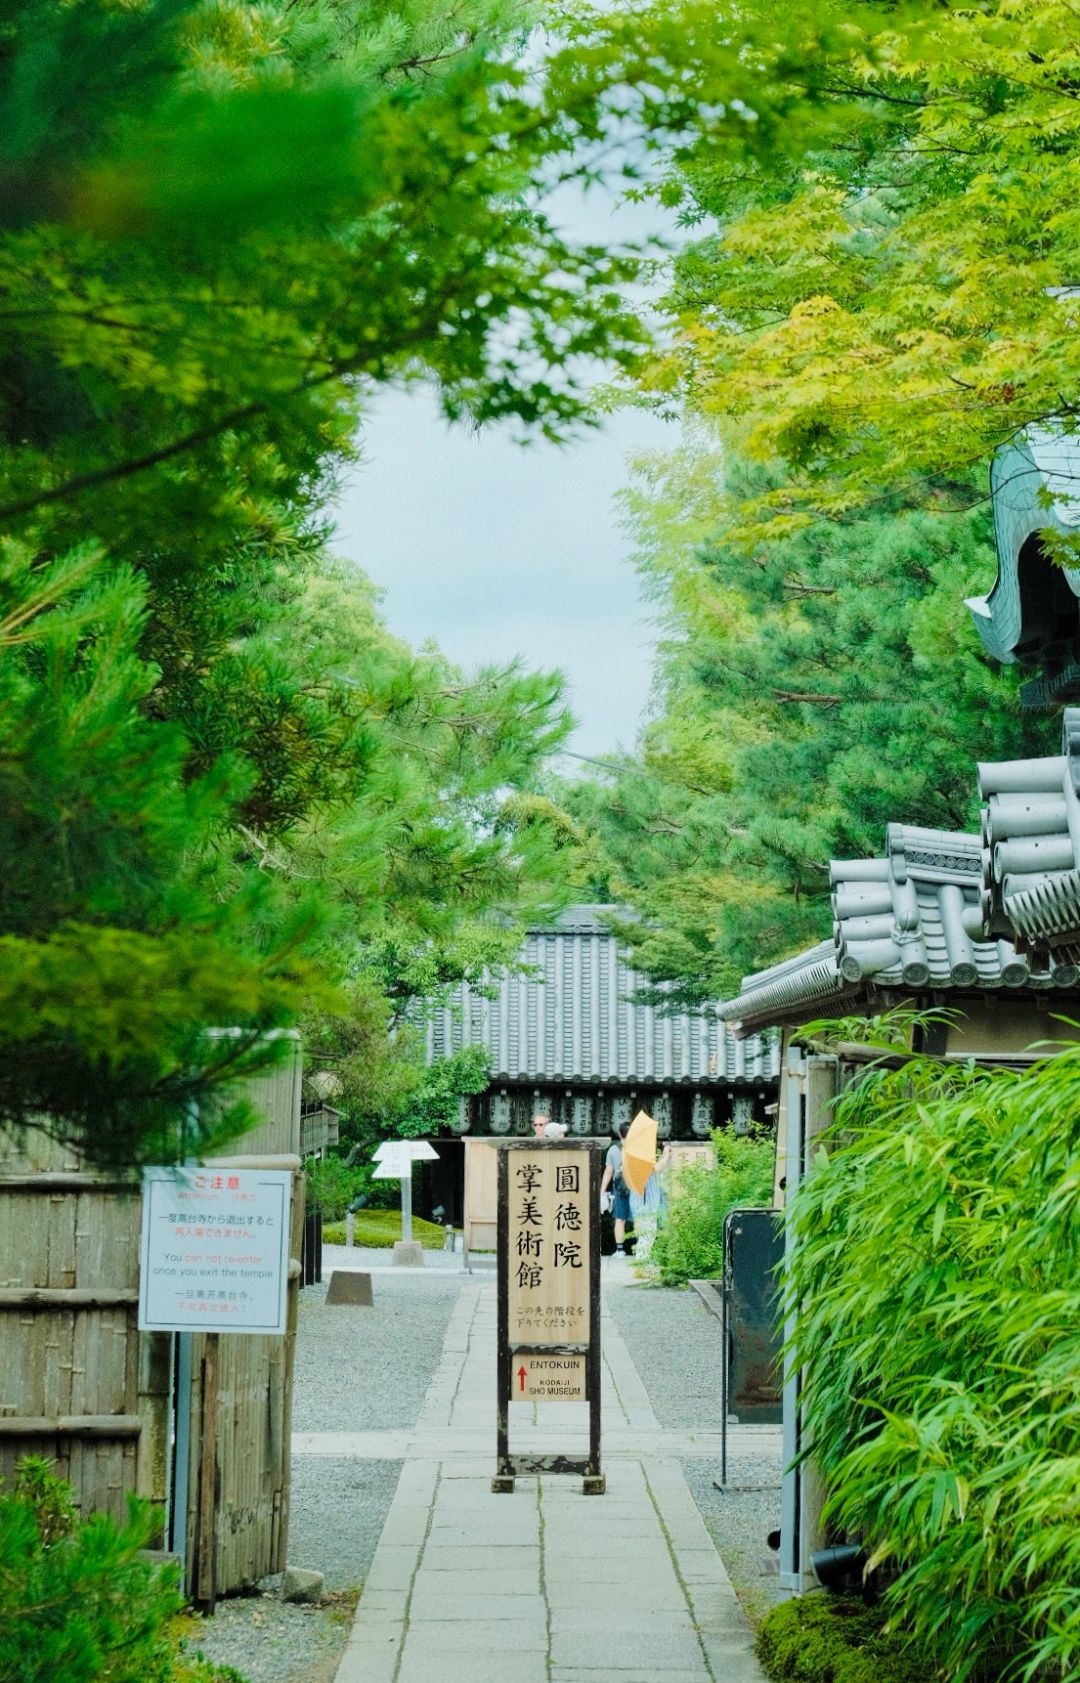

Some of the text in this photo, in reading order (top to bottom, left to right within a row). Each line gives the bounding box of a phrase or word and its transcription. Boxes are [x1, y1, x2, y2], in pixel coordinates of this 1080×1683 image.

[195, 1176, 240, 1190] ご注意
[554, 1165, 582, 1268] 圓徳院
[516, 1164, 544, 1289] 掌美術館
[164, 1253, 182, 1262] You
[185, 1254, 203, 1263] can
[205, 1254, 221, 1264] not
[153, 1267, 177, 1276] once
[180, 1268, 198, 1278] you
[200, 1268, 218, 1277] exit
[222, 1269, 238, 1278] the
[516, 1306, 585, 1316] この先の階段を
[516, 1319, 578, 1328] 下りてください
[530, 1361, 580, 1369] ENTOKUIN
[529, 1387, 581, 1395] SHO MUSEUM
